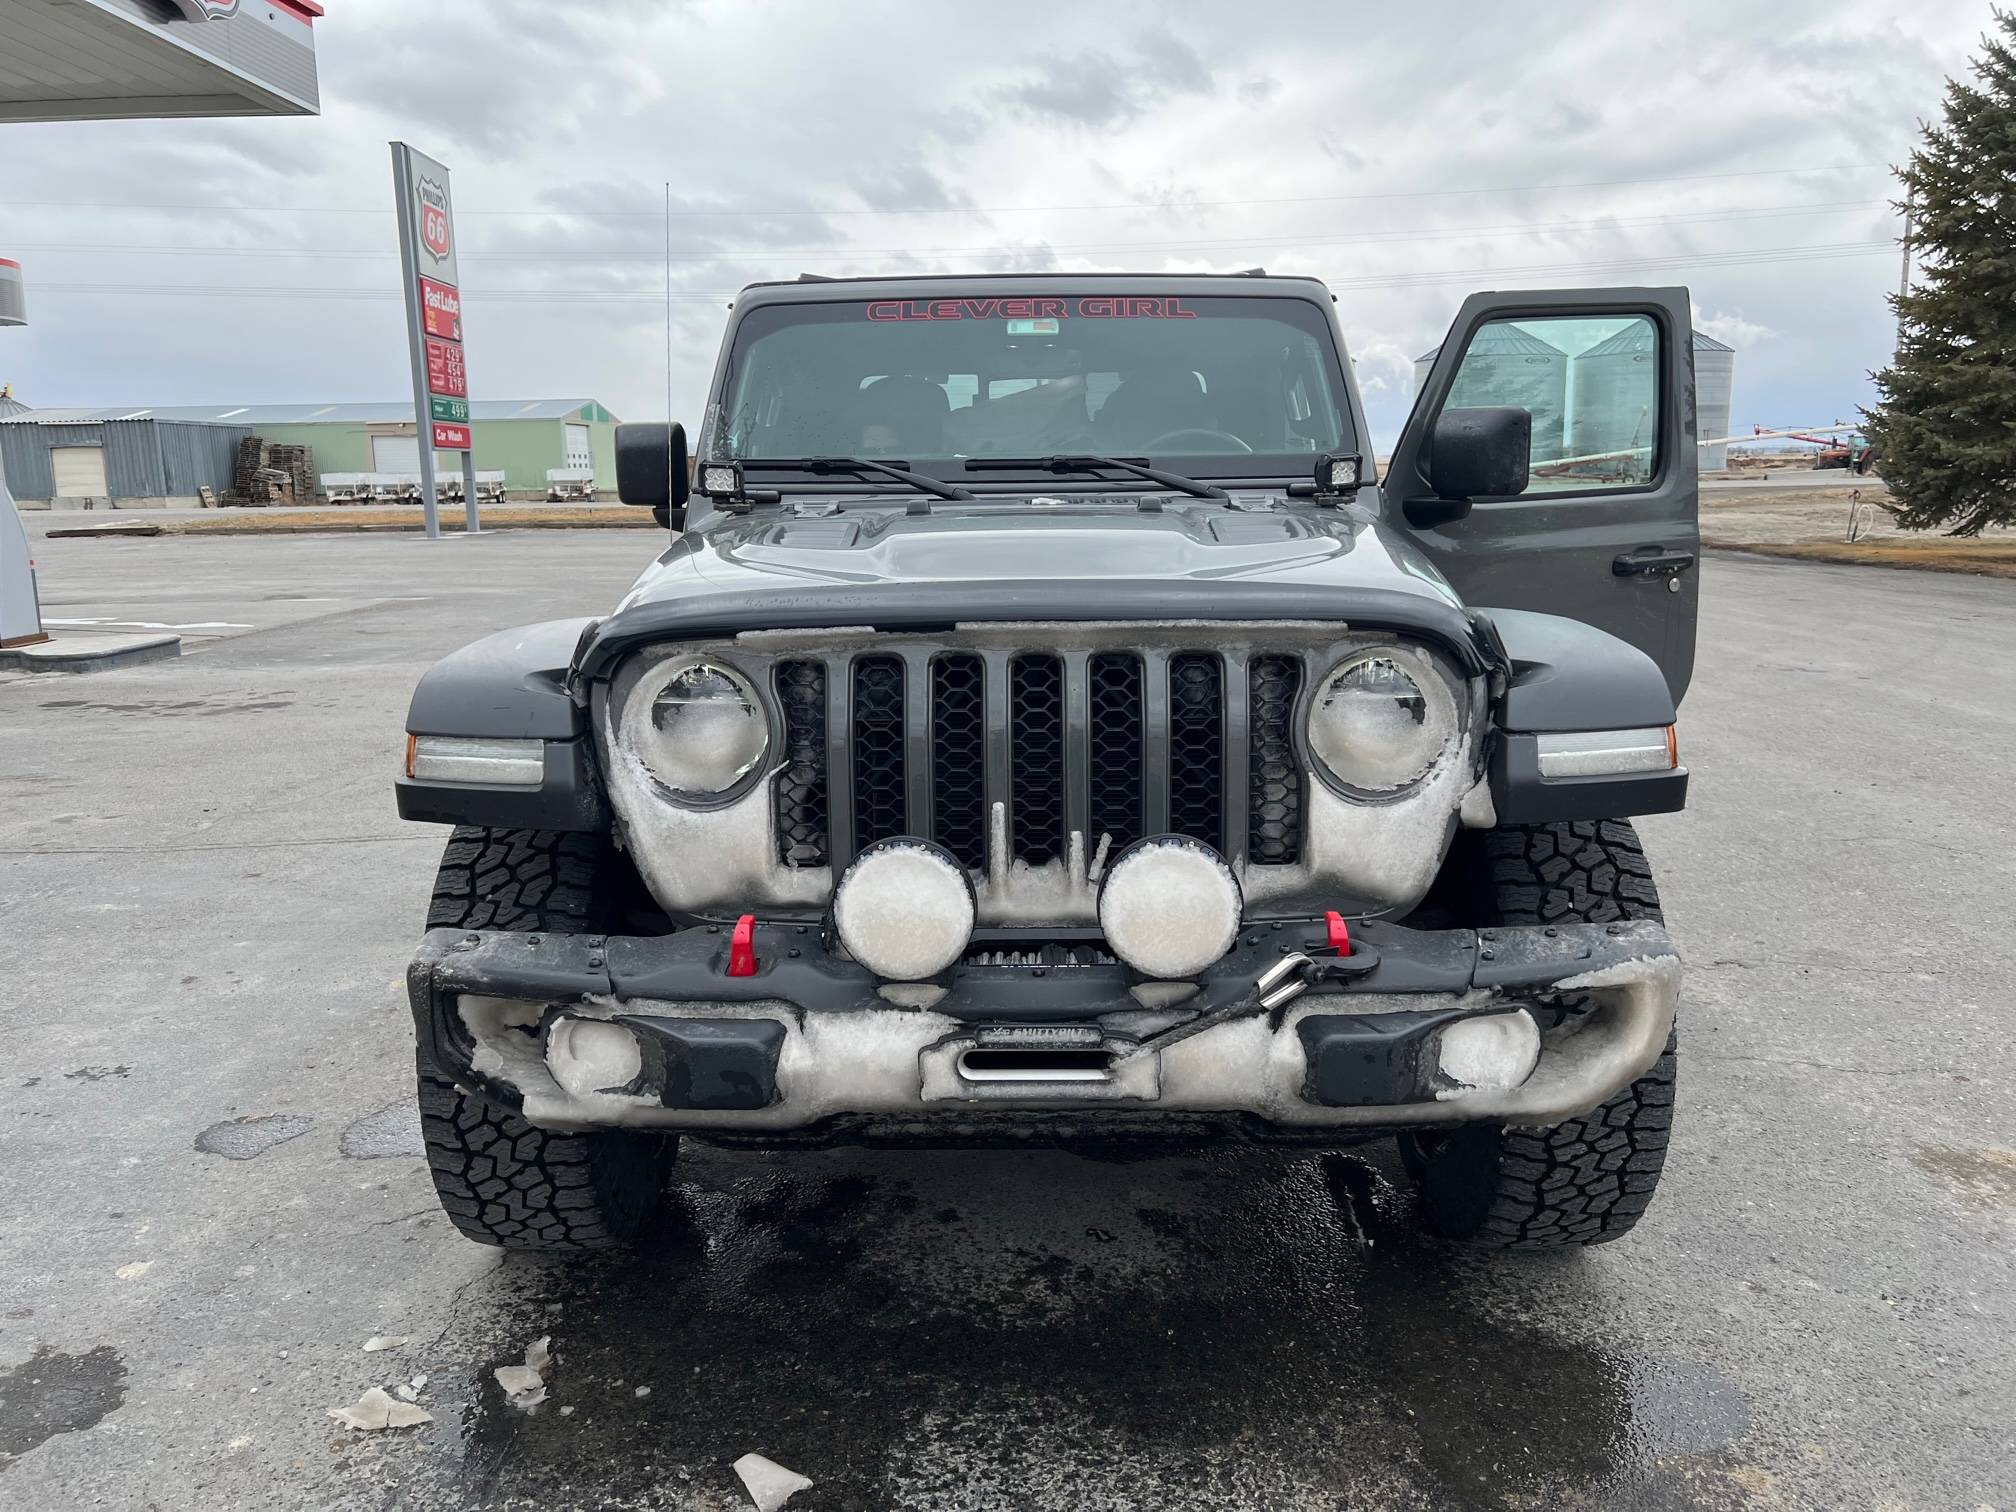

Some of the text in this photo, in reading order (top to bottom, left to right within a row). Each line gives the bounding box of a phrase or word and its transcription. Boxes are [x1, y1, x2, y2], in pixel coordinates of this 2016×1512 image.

[427, 211, 445, 244] 66
[425, 286, 459, 314] Fast Lube
[867, 298, 1198, 321] CLEVER GIRL
[436, 429, 463, 442] Car Wash
